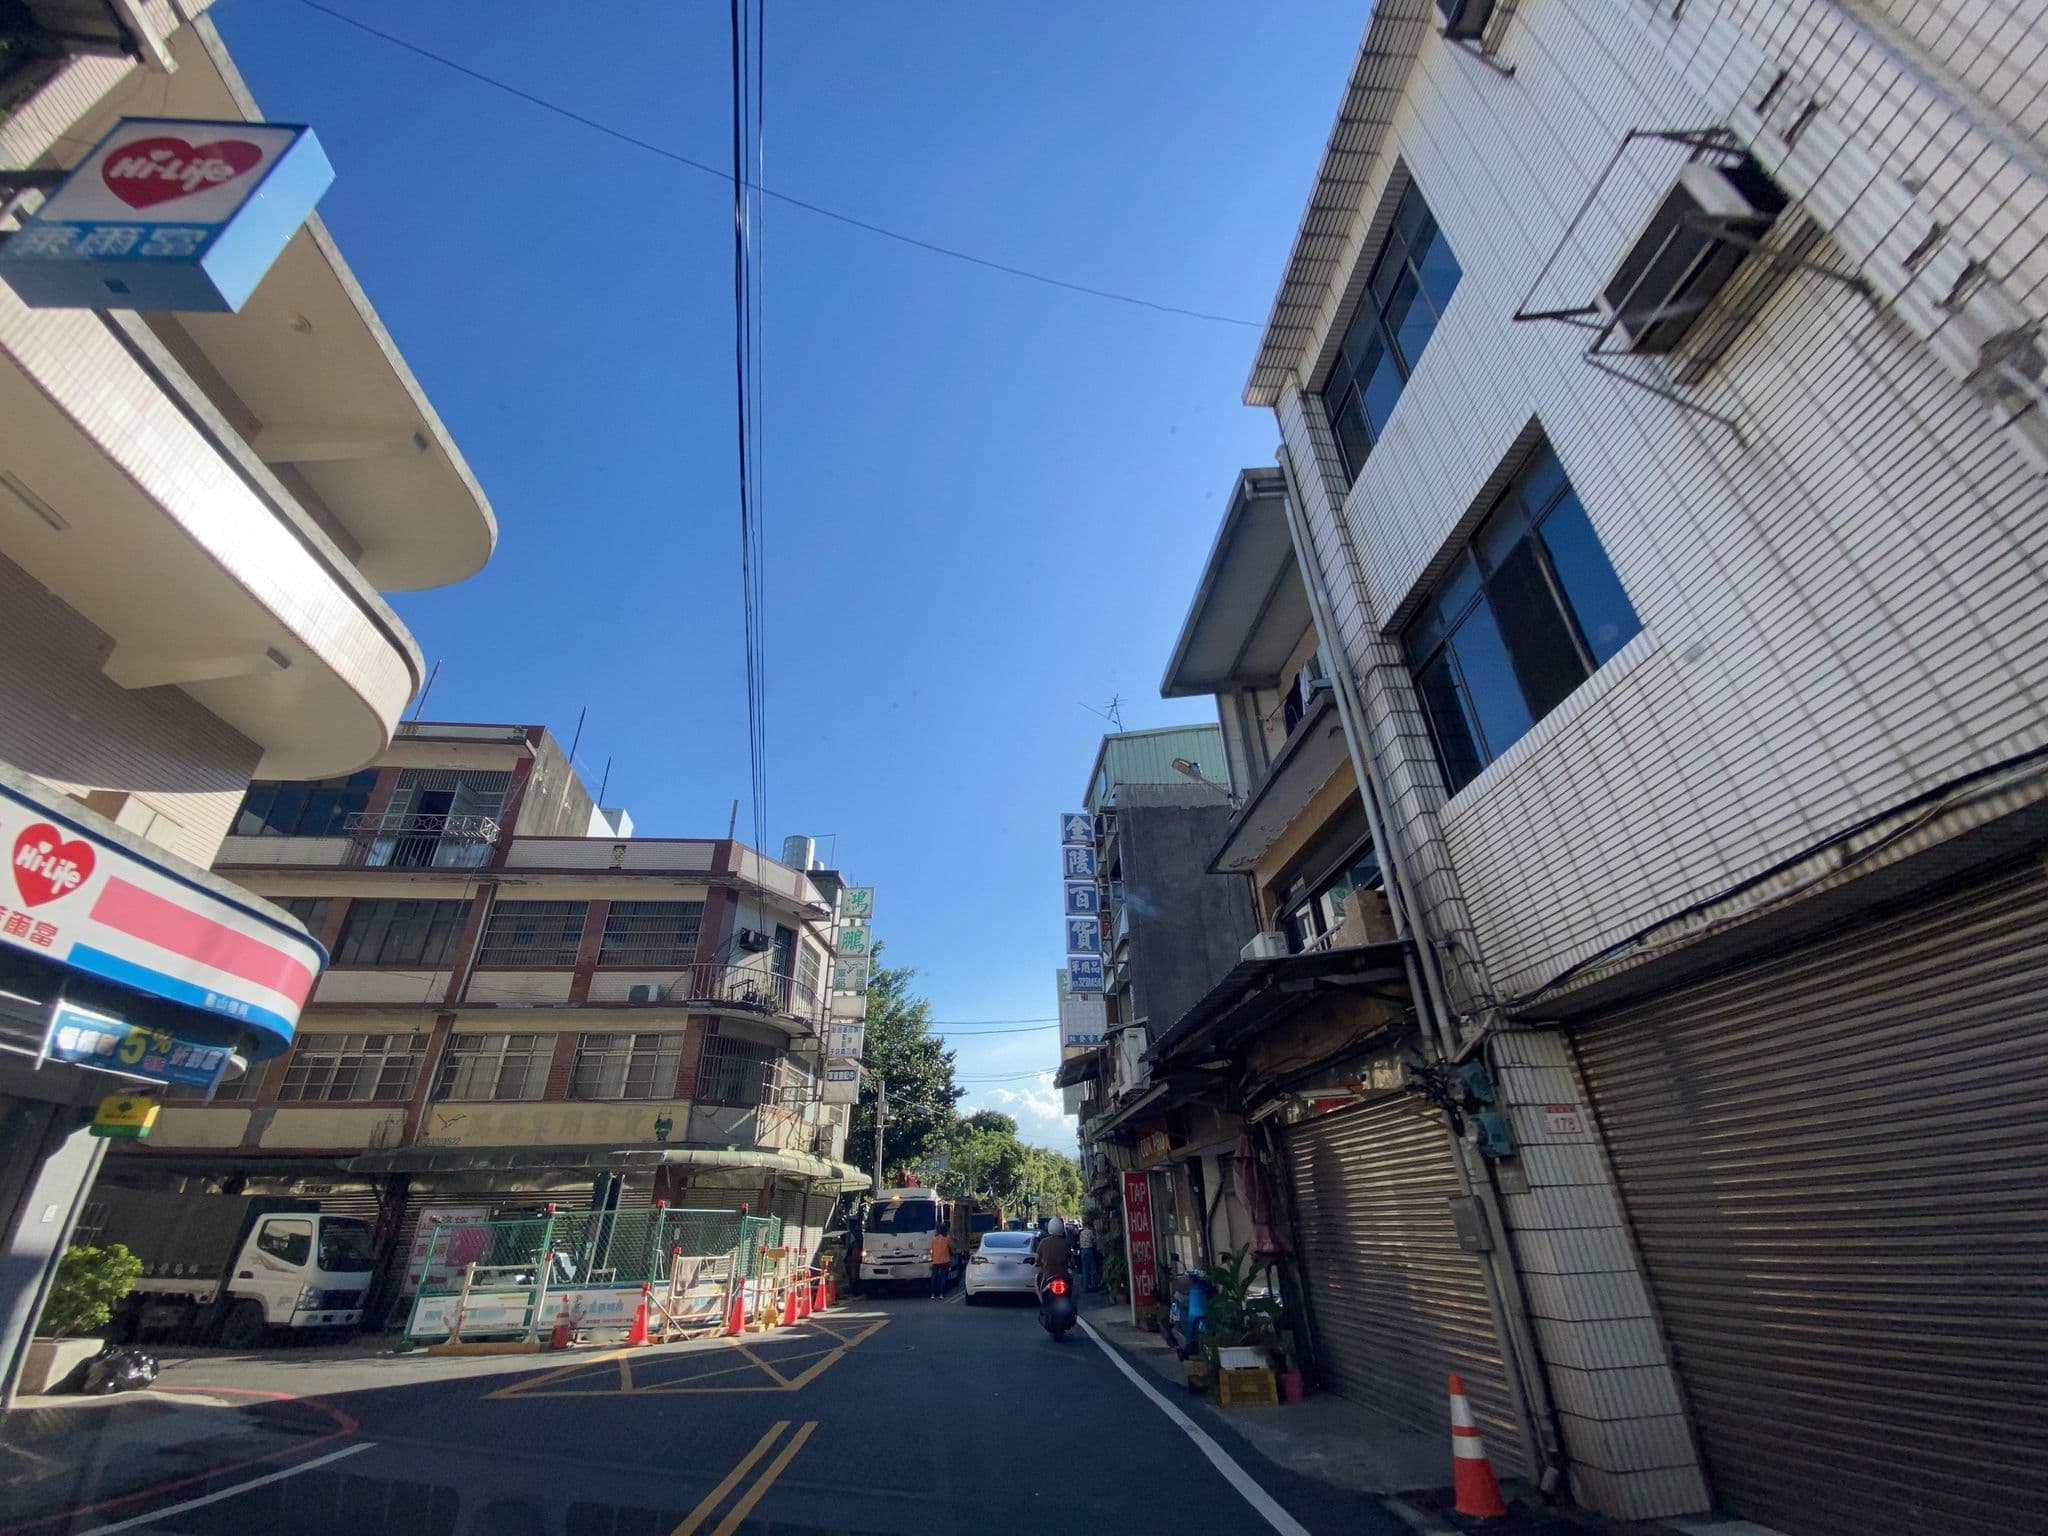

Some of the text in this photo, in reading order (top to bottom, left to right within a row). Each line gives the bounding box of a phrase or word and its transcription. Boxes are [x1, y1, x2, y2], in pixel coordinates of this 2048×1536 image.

[109, 149, 236, 192] Hi-Life
[15, 840, 82, 896] Hi-Life
[1066, 816, 1097, 950] 金陵百貨
